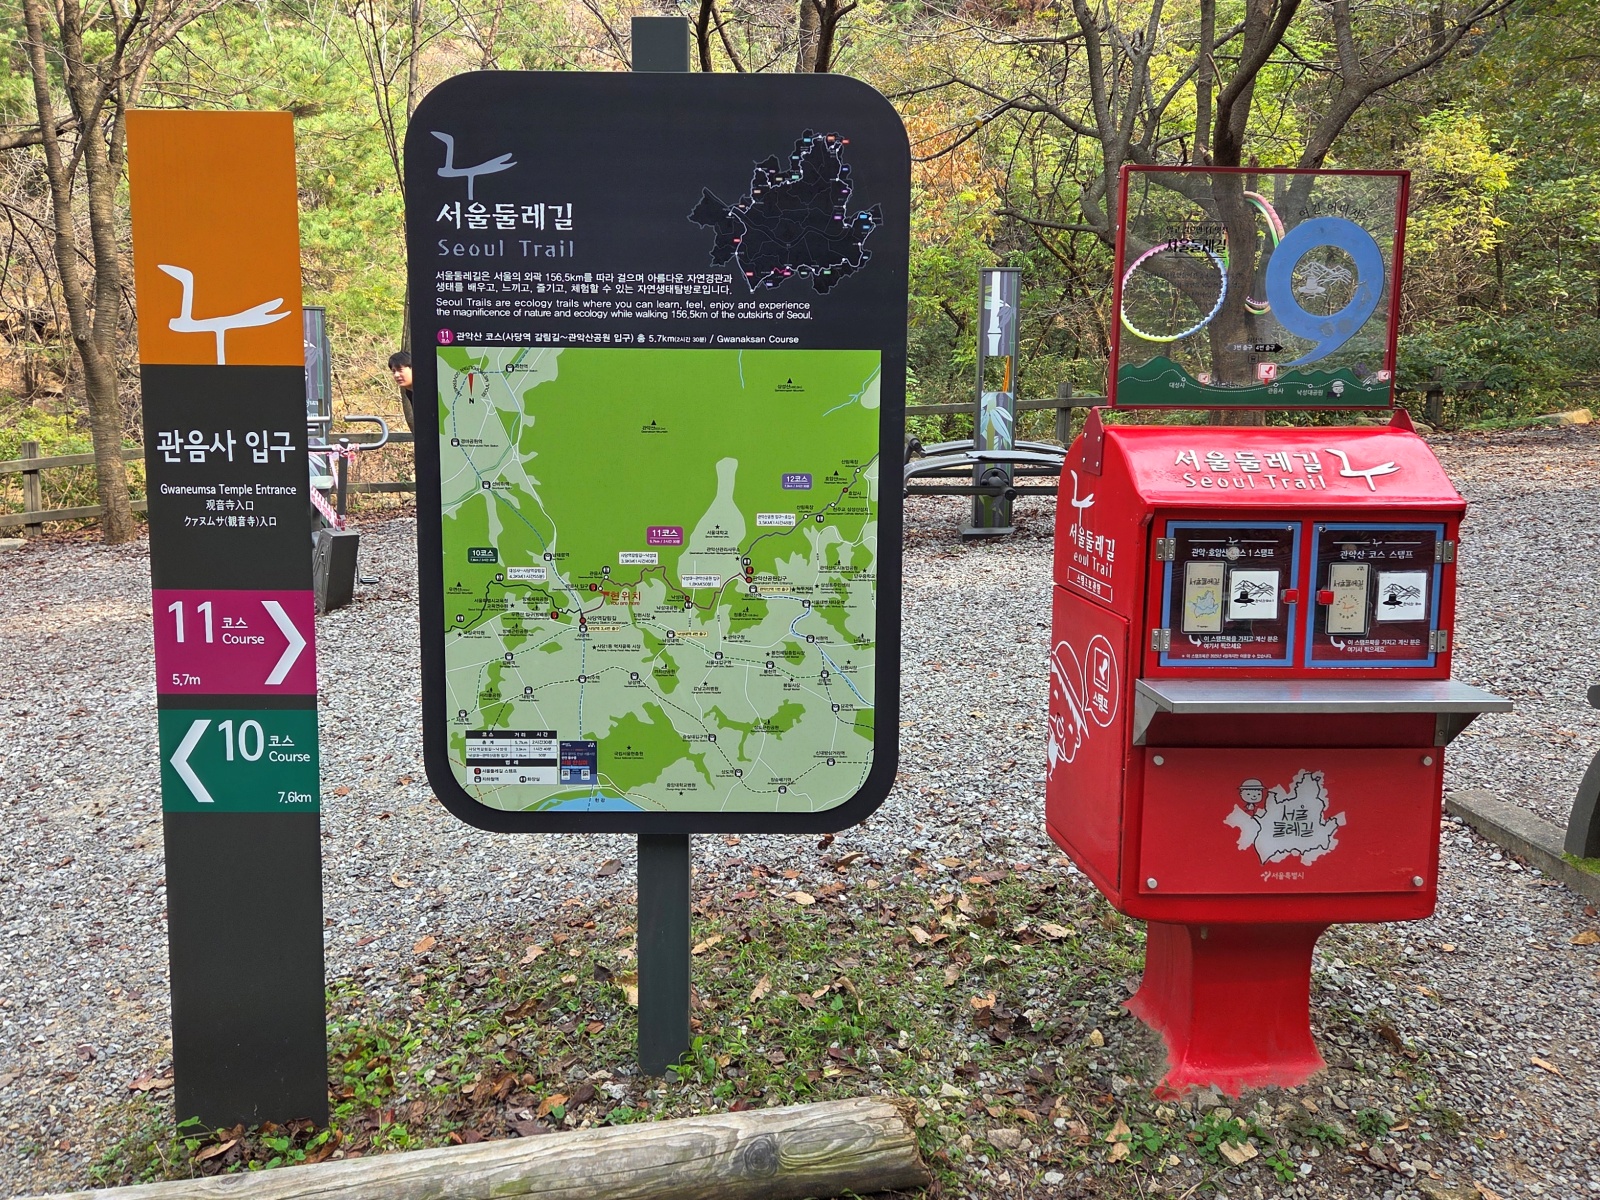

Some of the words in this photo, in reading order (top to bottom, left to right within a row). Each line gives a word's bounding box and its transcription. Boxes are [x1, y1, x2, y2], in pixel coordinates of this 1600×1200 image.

[437, 202, 572, 230] 서울둘레길
[438, 240, 503, 256] Seoul
[519, 240, 573, 257] Trail
[1165, 239, 1226, 253] 서울둘레길
[436, 271, 490, 281] 서울둘레길은
[494, 272, 520, 281] 서울의
[524, 272, 542, 281] 외곽
[546, 273, 593, 282] 156.5km를
[597, 273, 614, 282] 따라
[618, 273, 643, 283] 걸으며
[648, 274, 684, 283] 아름다운
[687, 274, 732, 283] 자연경관과
[436, 282, 463, 292] 생태를
[468, 283, 498, 292] 배우고,
[502, 283, 532, 293] 느끼고,
[537, 283, 567, 293] 즐기고,
[571, 284, 599, 293] 체험할
[602, 284, 611, 293] 수
[616, 284, 633, 293] 있는
[638, 285, 732, 294] 자연생태탐방로입니다.
[436, 298, 462, 306] Seoul
[467, 298, 491, 307] Trails
[515, 299, 552, 308] ecology
[557, 299, 579, 307] trails
[657, 300, 682, 309] learn,
[686, 301, 705, 310] feel,
[710, 301, 734, 310] enjoy
[738, 301, 755, 309] and
[759, 301, 810, 310] experience
[437, 308, 450, 316] the
[453, 308, 510, 317] magnificence
[554, 309, 571, 317] and
[574, 309, 608, 318] ecology
[635, 310, 668, 319] walking
[672, 310, 708, 319] 156.5km
[776, 311, 784, 319] of
[787, 311, 812, 319] Seoul.
[457, 332, 482, 341] 관악산
[486, 332, 530, 341] 코스(사당역
[535, 333, 610, 342] 갈림길~관악산공원
[614, 334, 635, 342] 입구)
[637, 334, 645, 342] 총
[717, 335, 765, 343] Gwanaksan
[157, 430, 236, 462] 관음사
[246, 430, 295, 463] 입구
[1175, 450, 1322, 473] 서울둘레길
[1182, 473, 1255, 489] Seoul
[1263, 474, 1327, 490] Trail
[161, 484, 216, 494] Gwaneumsa
[219, 484, 252, 496] Temple
[256, 484, 296, 494] Entrance
[206, 499, 253, 510] 观音寺入口
[185, 516, 276, 527] クァヌムサ(観音寺)入口
[652, 529, 678, 537] 11코스
[1069, 523, 1115, 562] 서울둘레길
[1254, 548, 1274, 558] 스탬프
[1340, 550, 1365, 560] 관악산
[1368, 550, 1385, 559] 코스
[1389, 550, 1413, 559] 스탬프
[1092, 557, 1112, 578] Trail
[169, 601, 213, 643] 11
[222, 617, 248, 628] 코스
[223, 633, 264, 644] Course
[173, 674, 200, 686] 5.7m
[1092, 691, 1109, 714] 스탬프
[219, 720, 264, 761] 10
[269, 735, 294, 746] 코스
[269, 751, 310, 761] Course
[278, 792, 311, 803] 7.6km
[1282, 804, 1309, 821] 서울
[1272, 821, 1314, 837] 둘레길
[1271, 871, 1304, 880] 서울특별시
